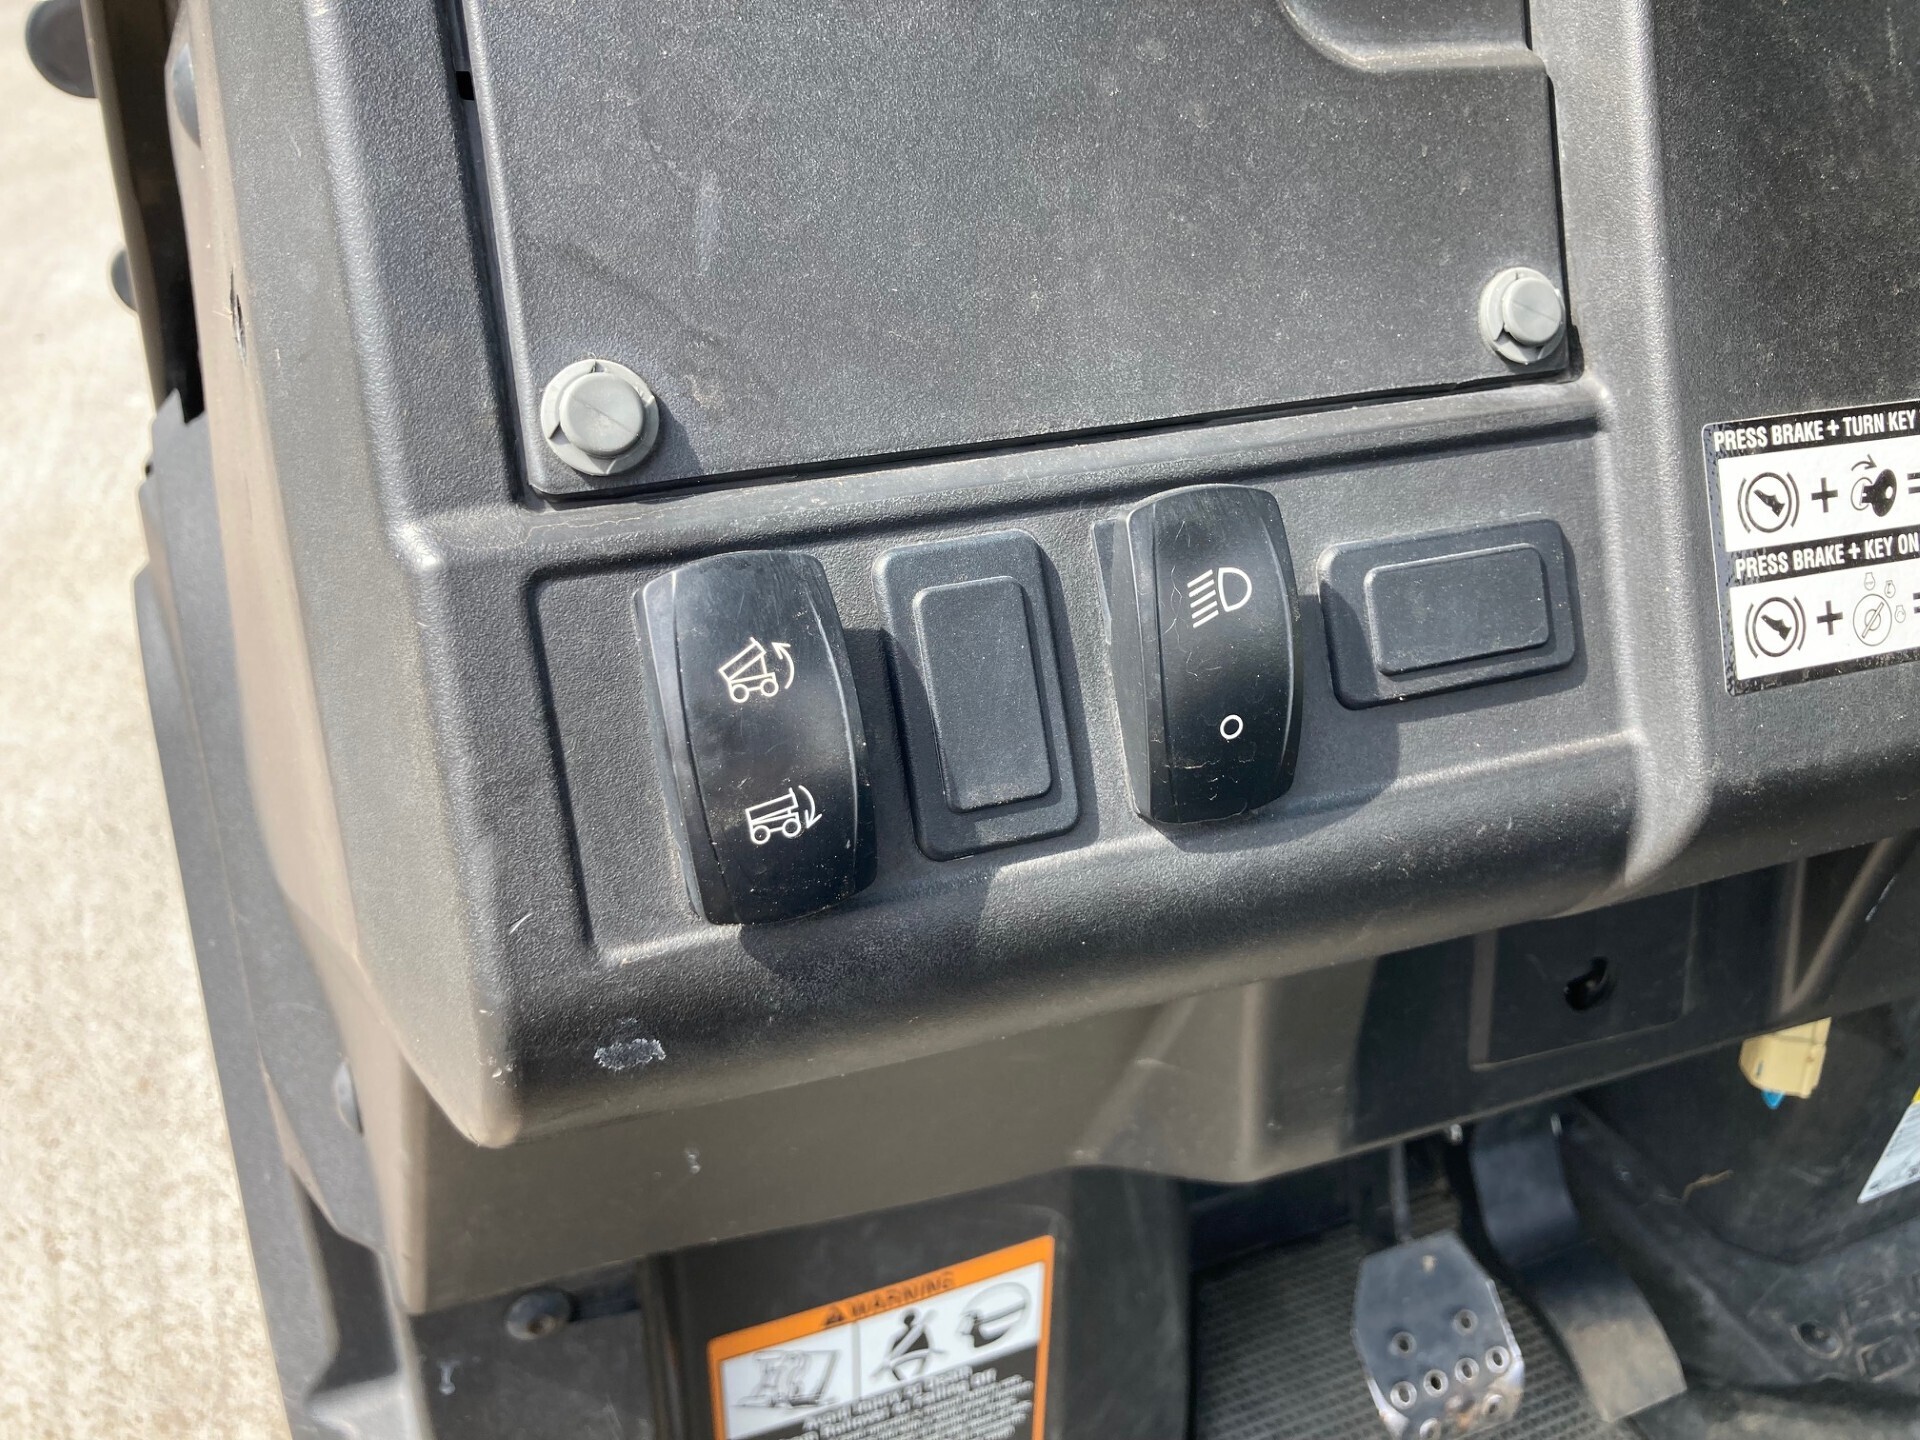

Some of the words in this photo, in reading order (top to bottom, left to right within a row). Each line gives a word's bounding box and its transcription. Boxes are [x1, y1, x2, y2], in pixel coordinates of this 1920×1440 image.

[1713, 426, 1768, 450] PRESS
[1771, 420, 1824, 446] BRAKE
[1843, 414, 1885, 437] TURN
[1888, 409, 1916, 432] KEY
[1735, 551, 1789, 580] PRESS
[1793, 543, 1845, 571] BRAKE
[1864, 536, 1894, 560] KEY
[1898, 531, 1919, 554] ON
[851, 1270, 954, 1317] WARNING
